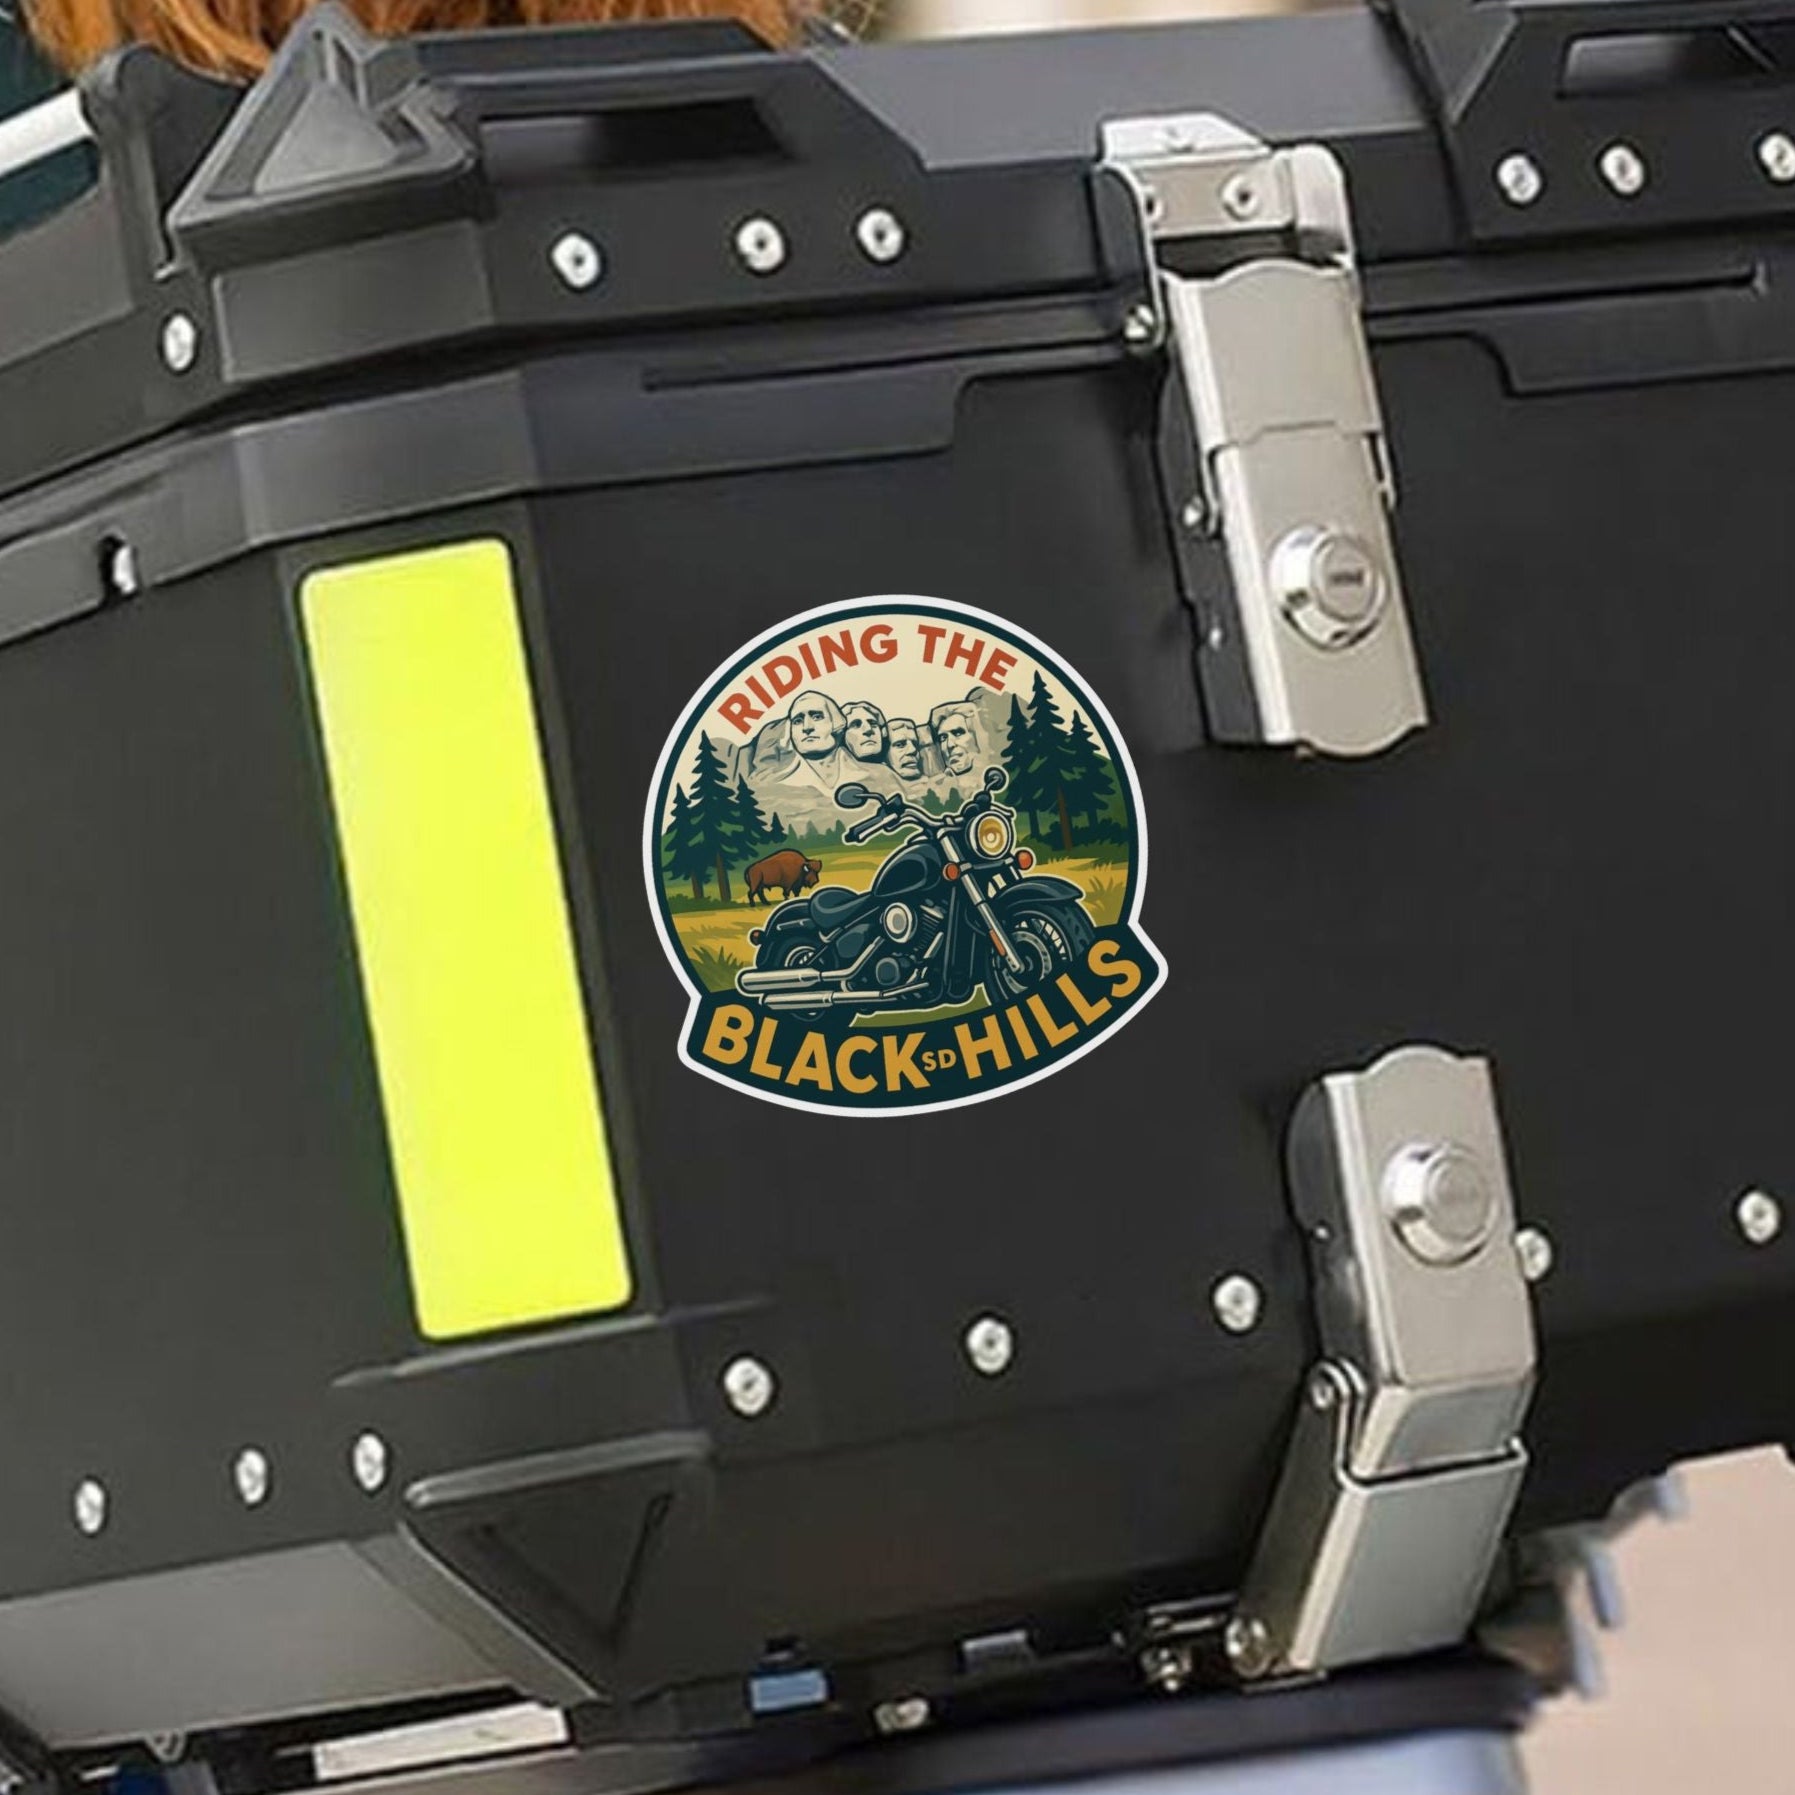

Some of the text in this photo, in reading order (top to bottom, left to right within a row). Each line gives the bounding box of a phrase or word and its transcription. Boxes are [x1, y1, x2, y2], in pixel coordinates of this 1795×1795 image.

[717, 624, 1018, 735] RIDING THE
[702, 938, 1142, 1094] BLACK SD HILLS
